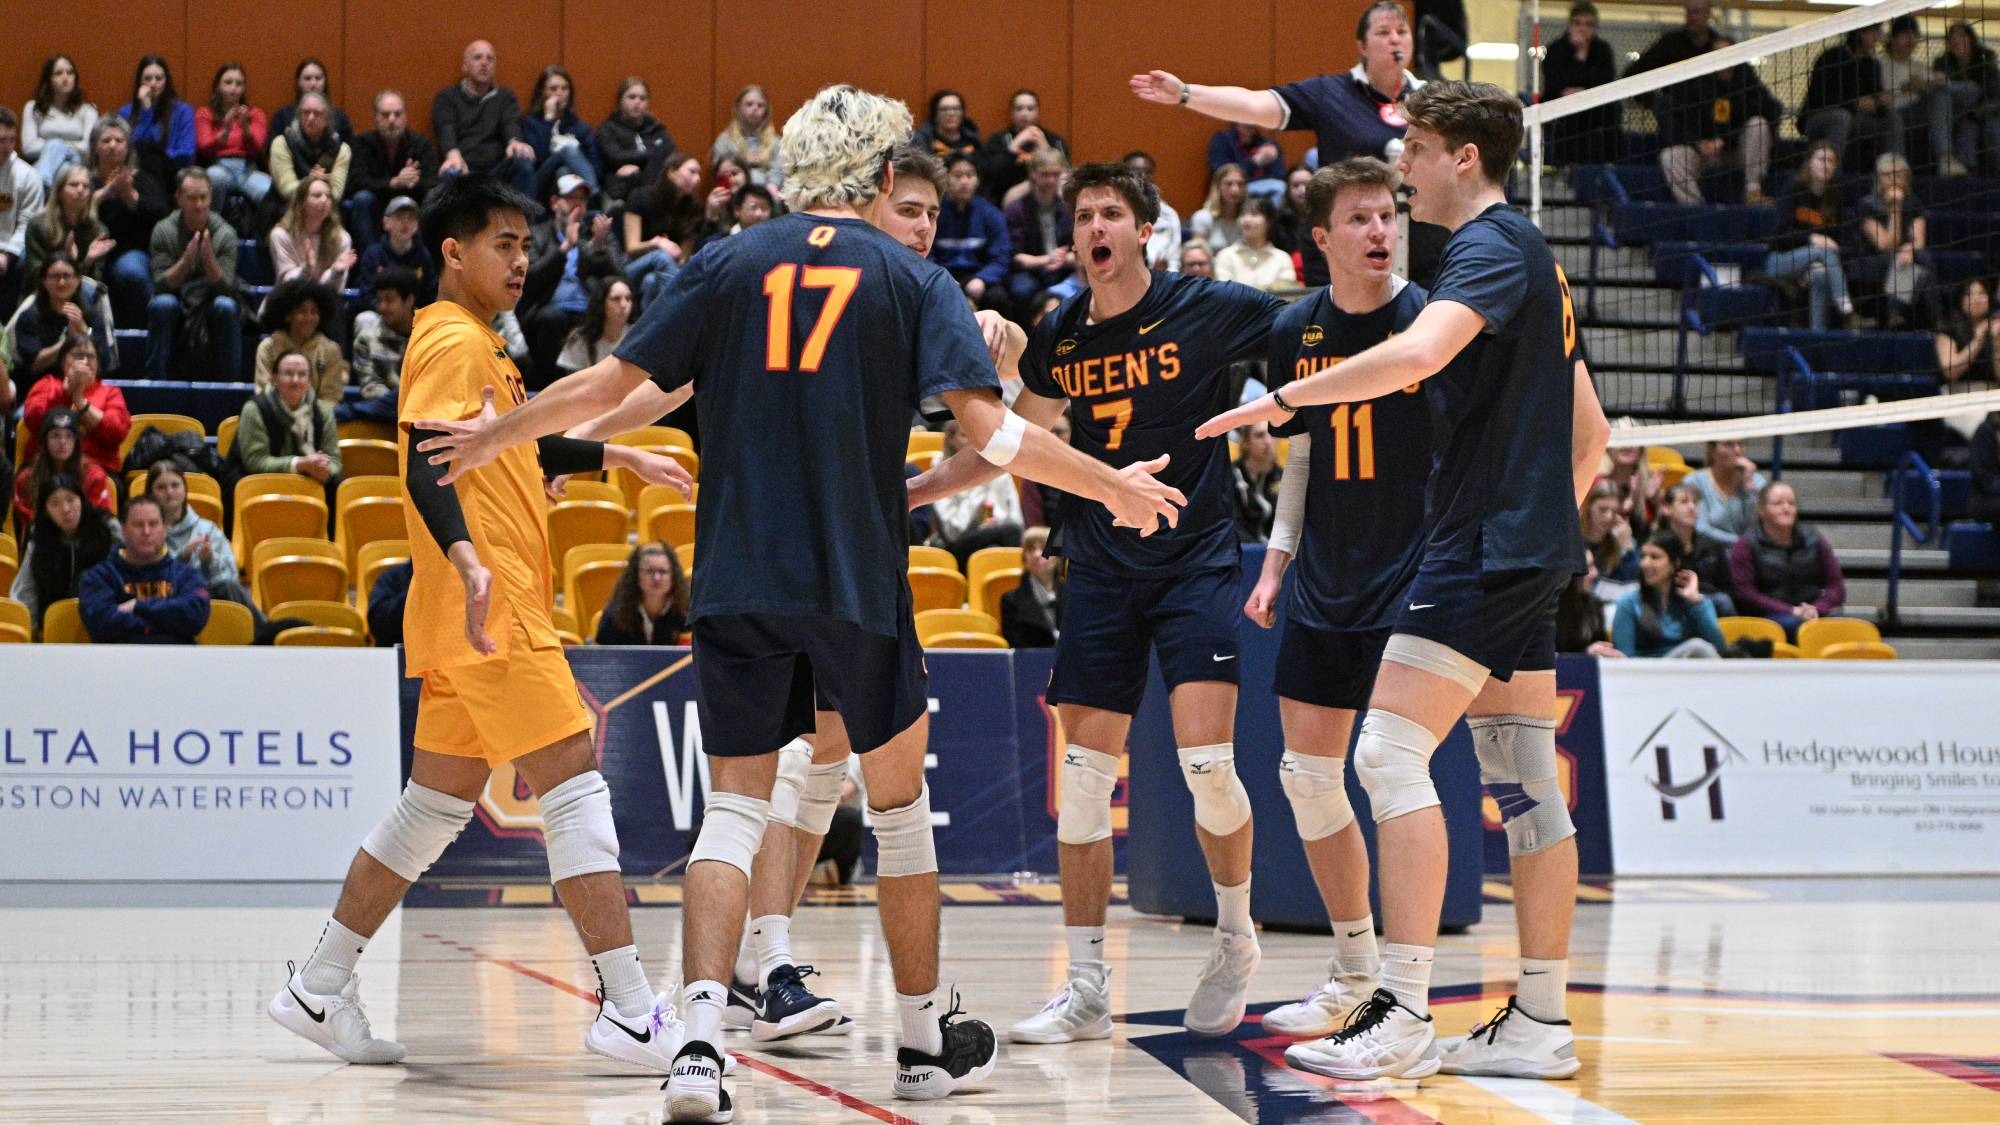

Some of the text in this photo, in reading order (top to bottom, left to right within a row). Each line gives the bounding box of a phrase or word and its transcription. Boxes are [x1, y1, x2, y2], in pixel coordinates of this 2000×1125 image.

[806, 224, 838, 250] Q
[762, 262, 863, 373] 17
[1051, 340, 1181, 397] QUEEN'S
[1091, 398, 1134, 450] 7
[1330, 401, 1377, 481] 11
[4, 728, 353, 766] LTA HOTELS
[1762, 740, 1929, 773] Hedgewood
[119, 785, 353, 810] WATERFRONT
[1851, 771, 1922, 790] Bringing
[1926, 771, 1978, 787] Smiles
